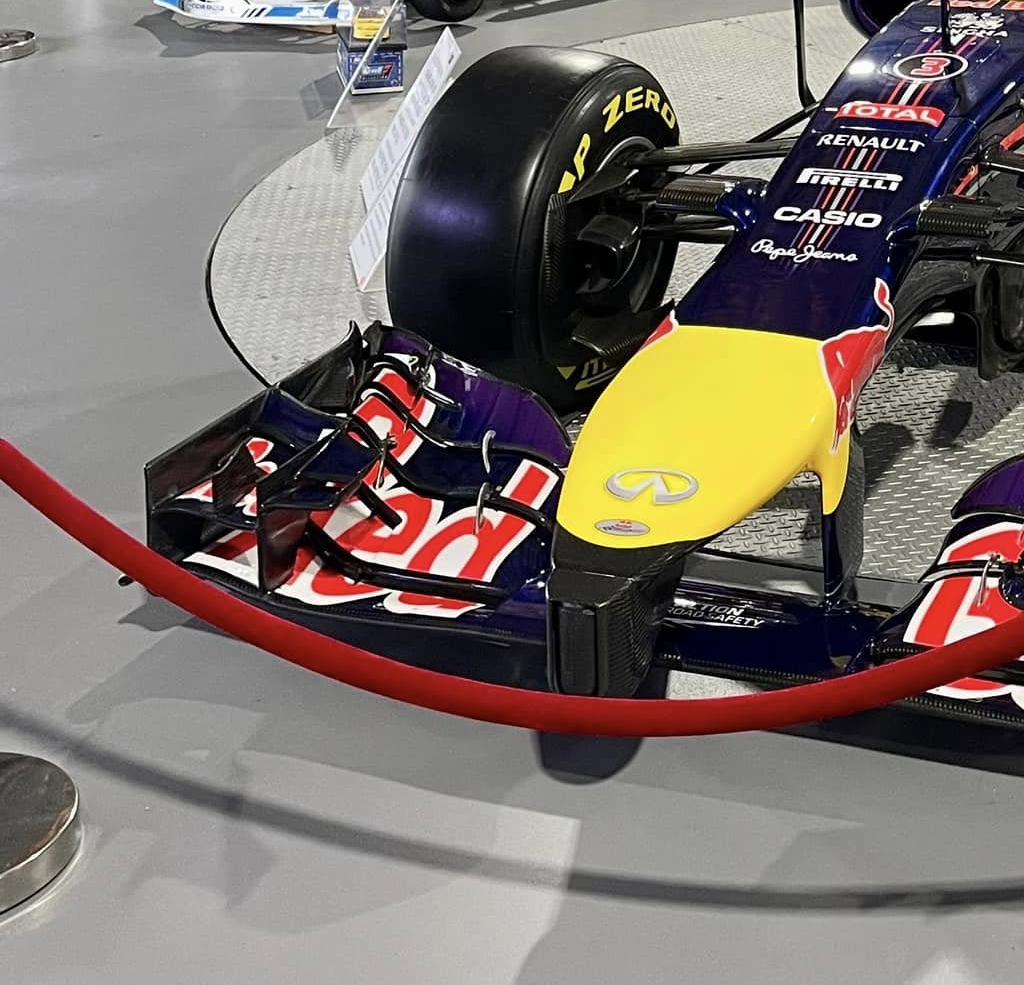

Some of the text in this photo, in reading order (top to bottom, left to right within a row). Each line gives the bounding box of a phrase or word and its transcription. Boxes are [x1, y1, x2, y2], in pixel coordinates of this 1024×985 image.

[910, 56, 951, 77] 3
[602, 86, 676, 133] ZERO
[841, 101, 938, 125] TOTAL
[816, 133, 926, 153] RENAULT
[796, 167, 904, 192] PIRELLI
[773, 205, 884, 229] CASIO
[750, 238, 859, 263] Pepe Jeans
[706, 612, 766, 627] SAFETY
